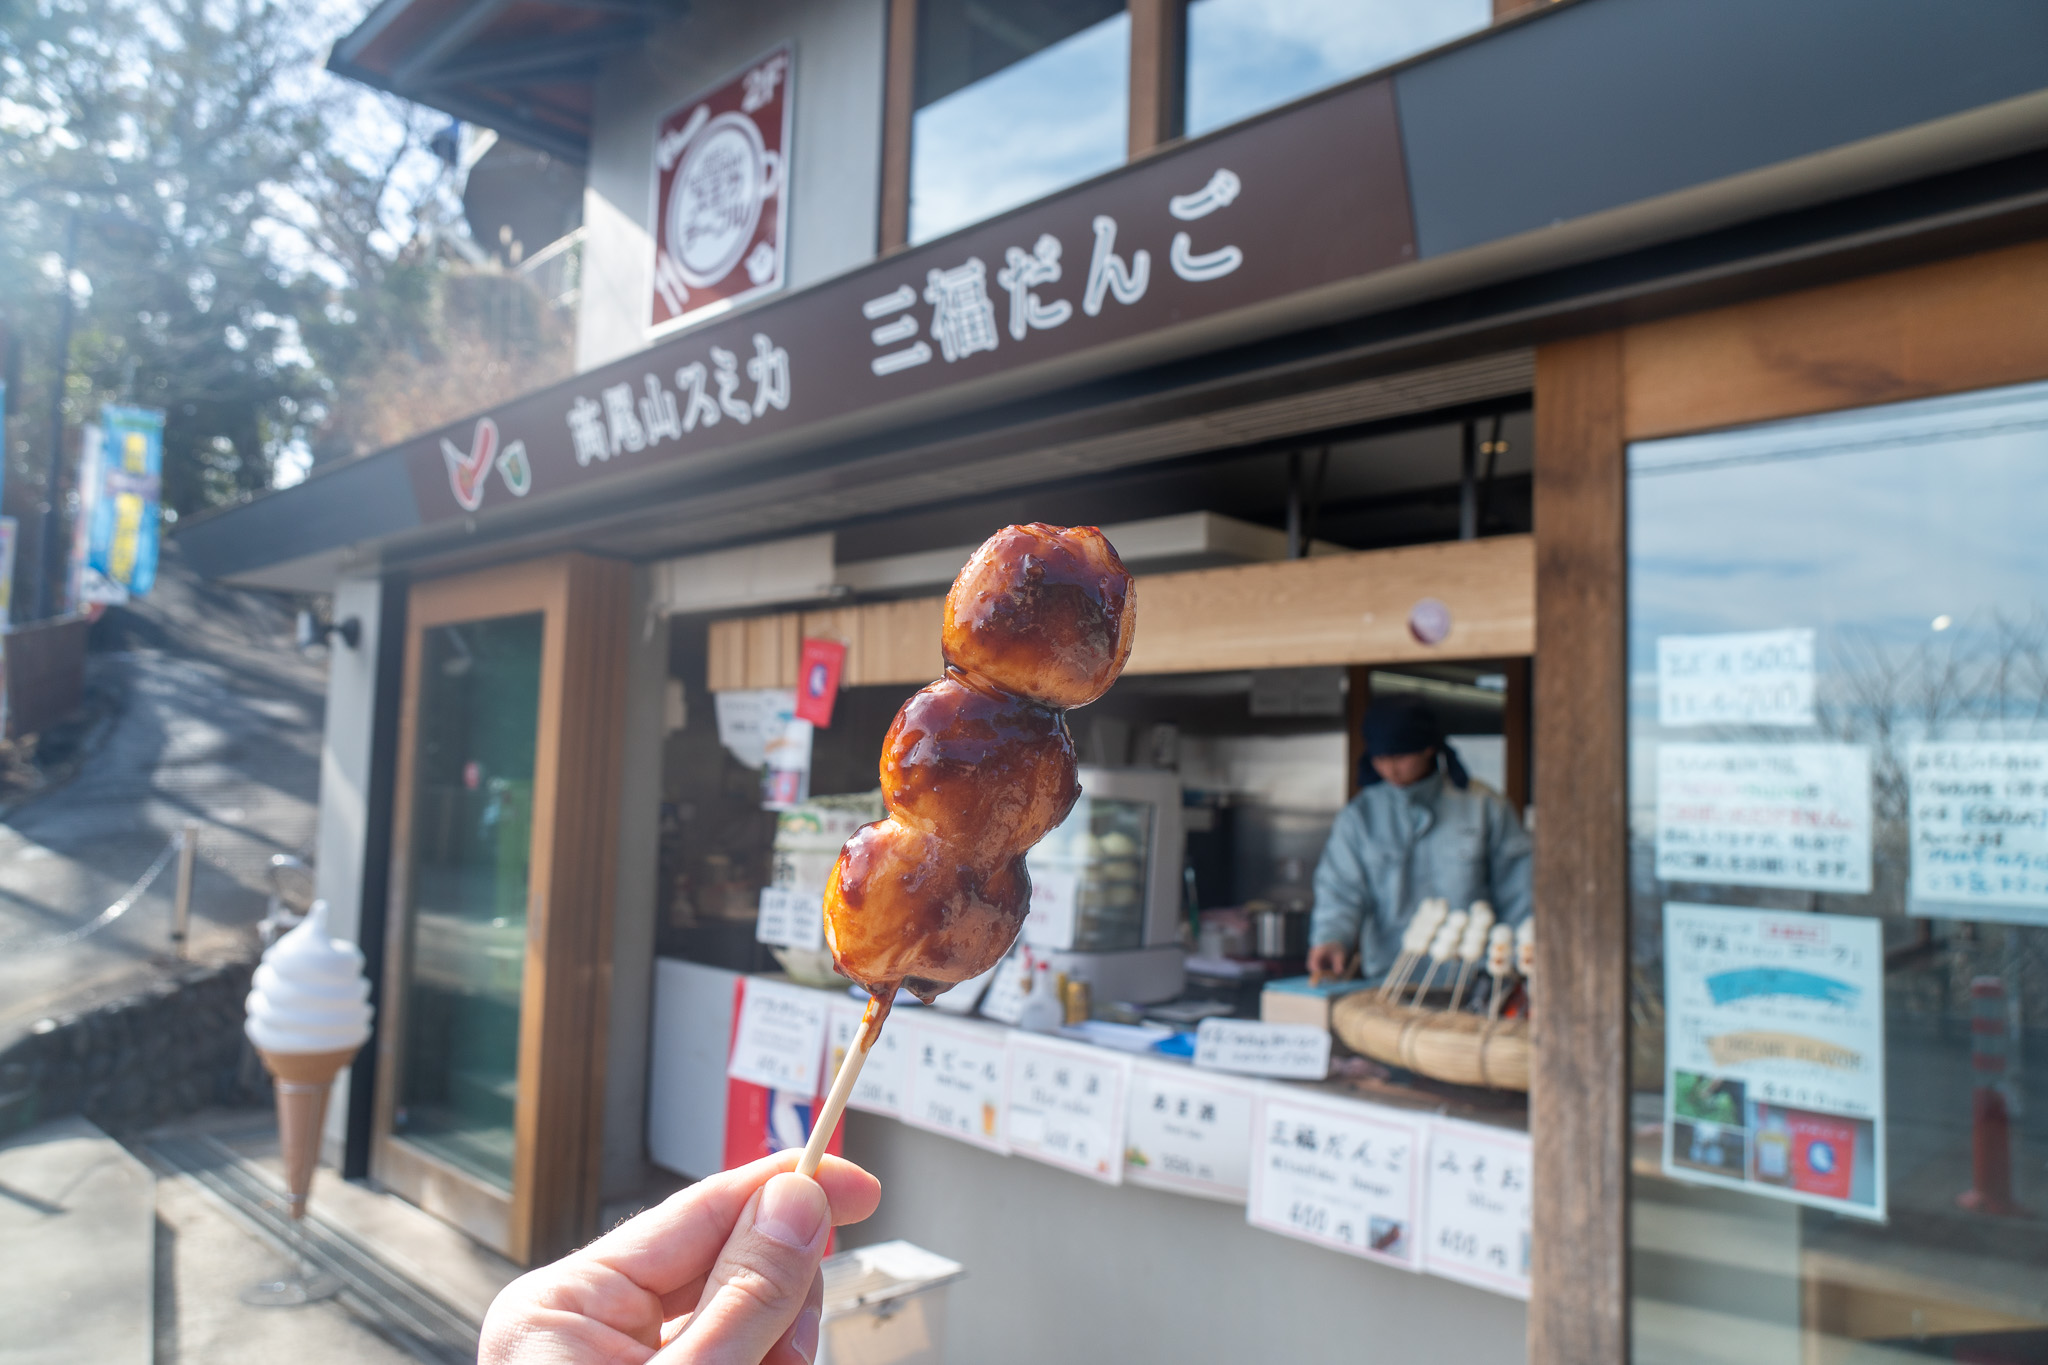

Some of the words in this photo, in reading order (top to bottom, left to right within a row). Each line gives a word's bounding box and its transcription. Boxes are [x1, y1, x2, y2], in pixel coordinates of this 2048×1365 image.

[741, 57, 788, 112] 2F
[566, 332, 792, 467] 高尾山スミカ
[863, 168, 1243, 376] 三福だんご
[1268, 1118, 1407, 1173] 三福だんご
